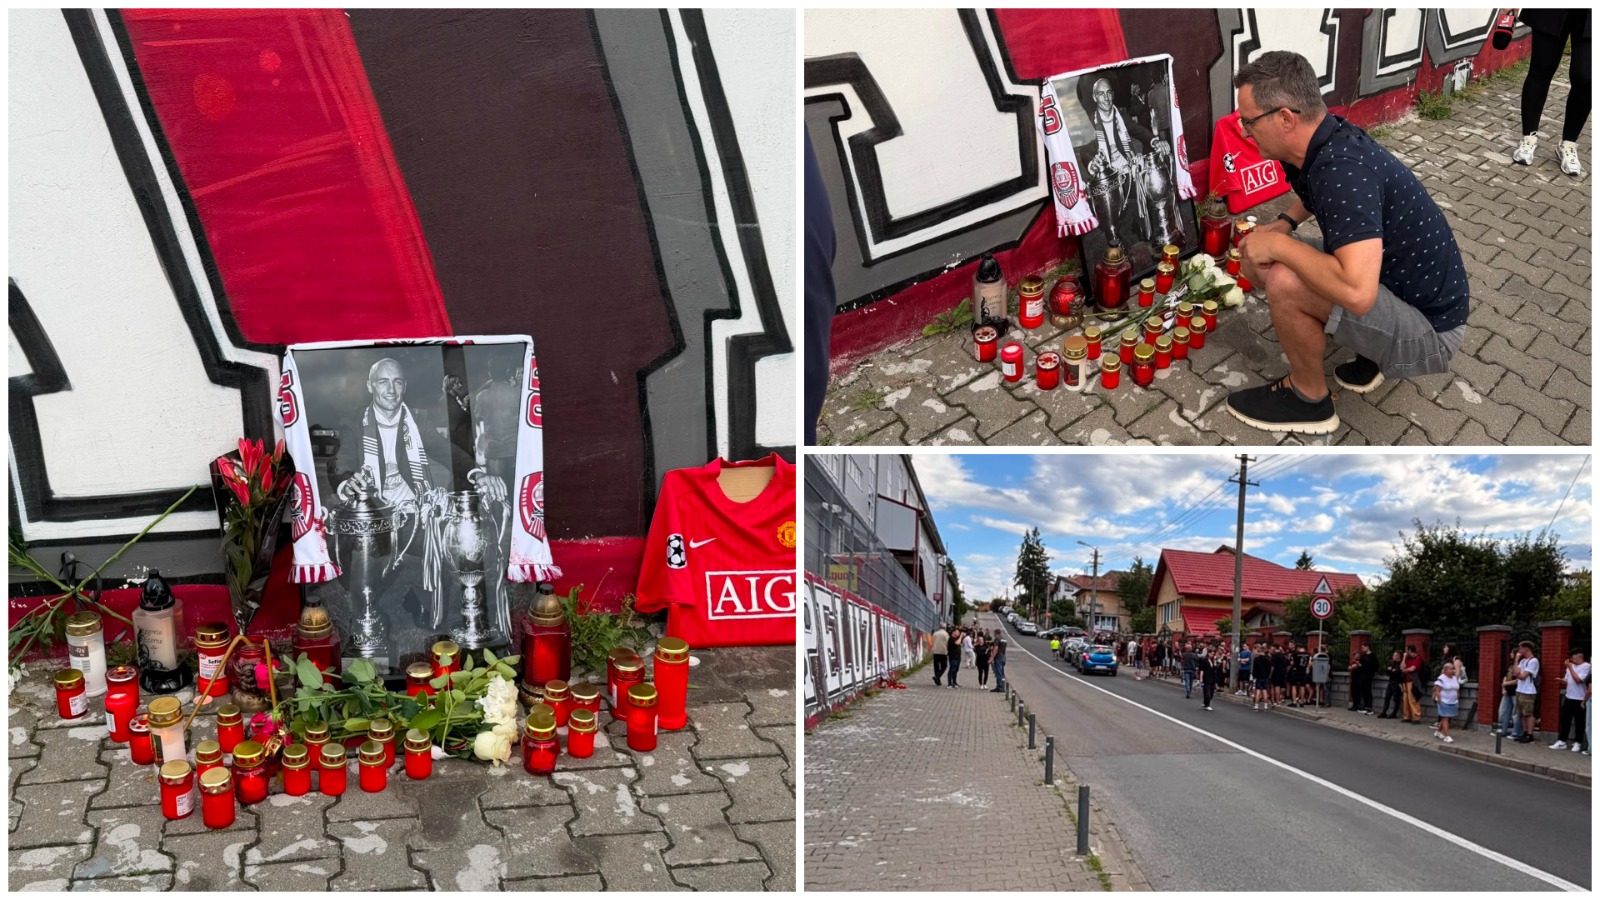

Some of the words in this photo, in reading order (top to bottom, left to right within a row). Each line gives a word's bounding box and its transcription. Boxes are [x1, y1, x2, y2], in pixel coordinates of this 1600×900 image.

[1246, 163, 1276, 193] AIG
[714, 576, 796, 613] AIG
[1316, 602, 1328, 613] 30
